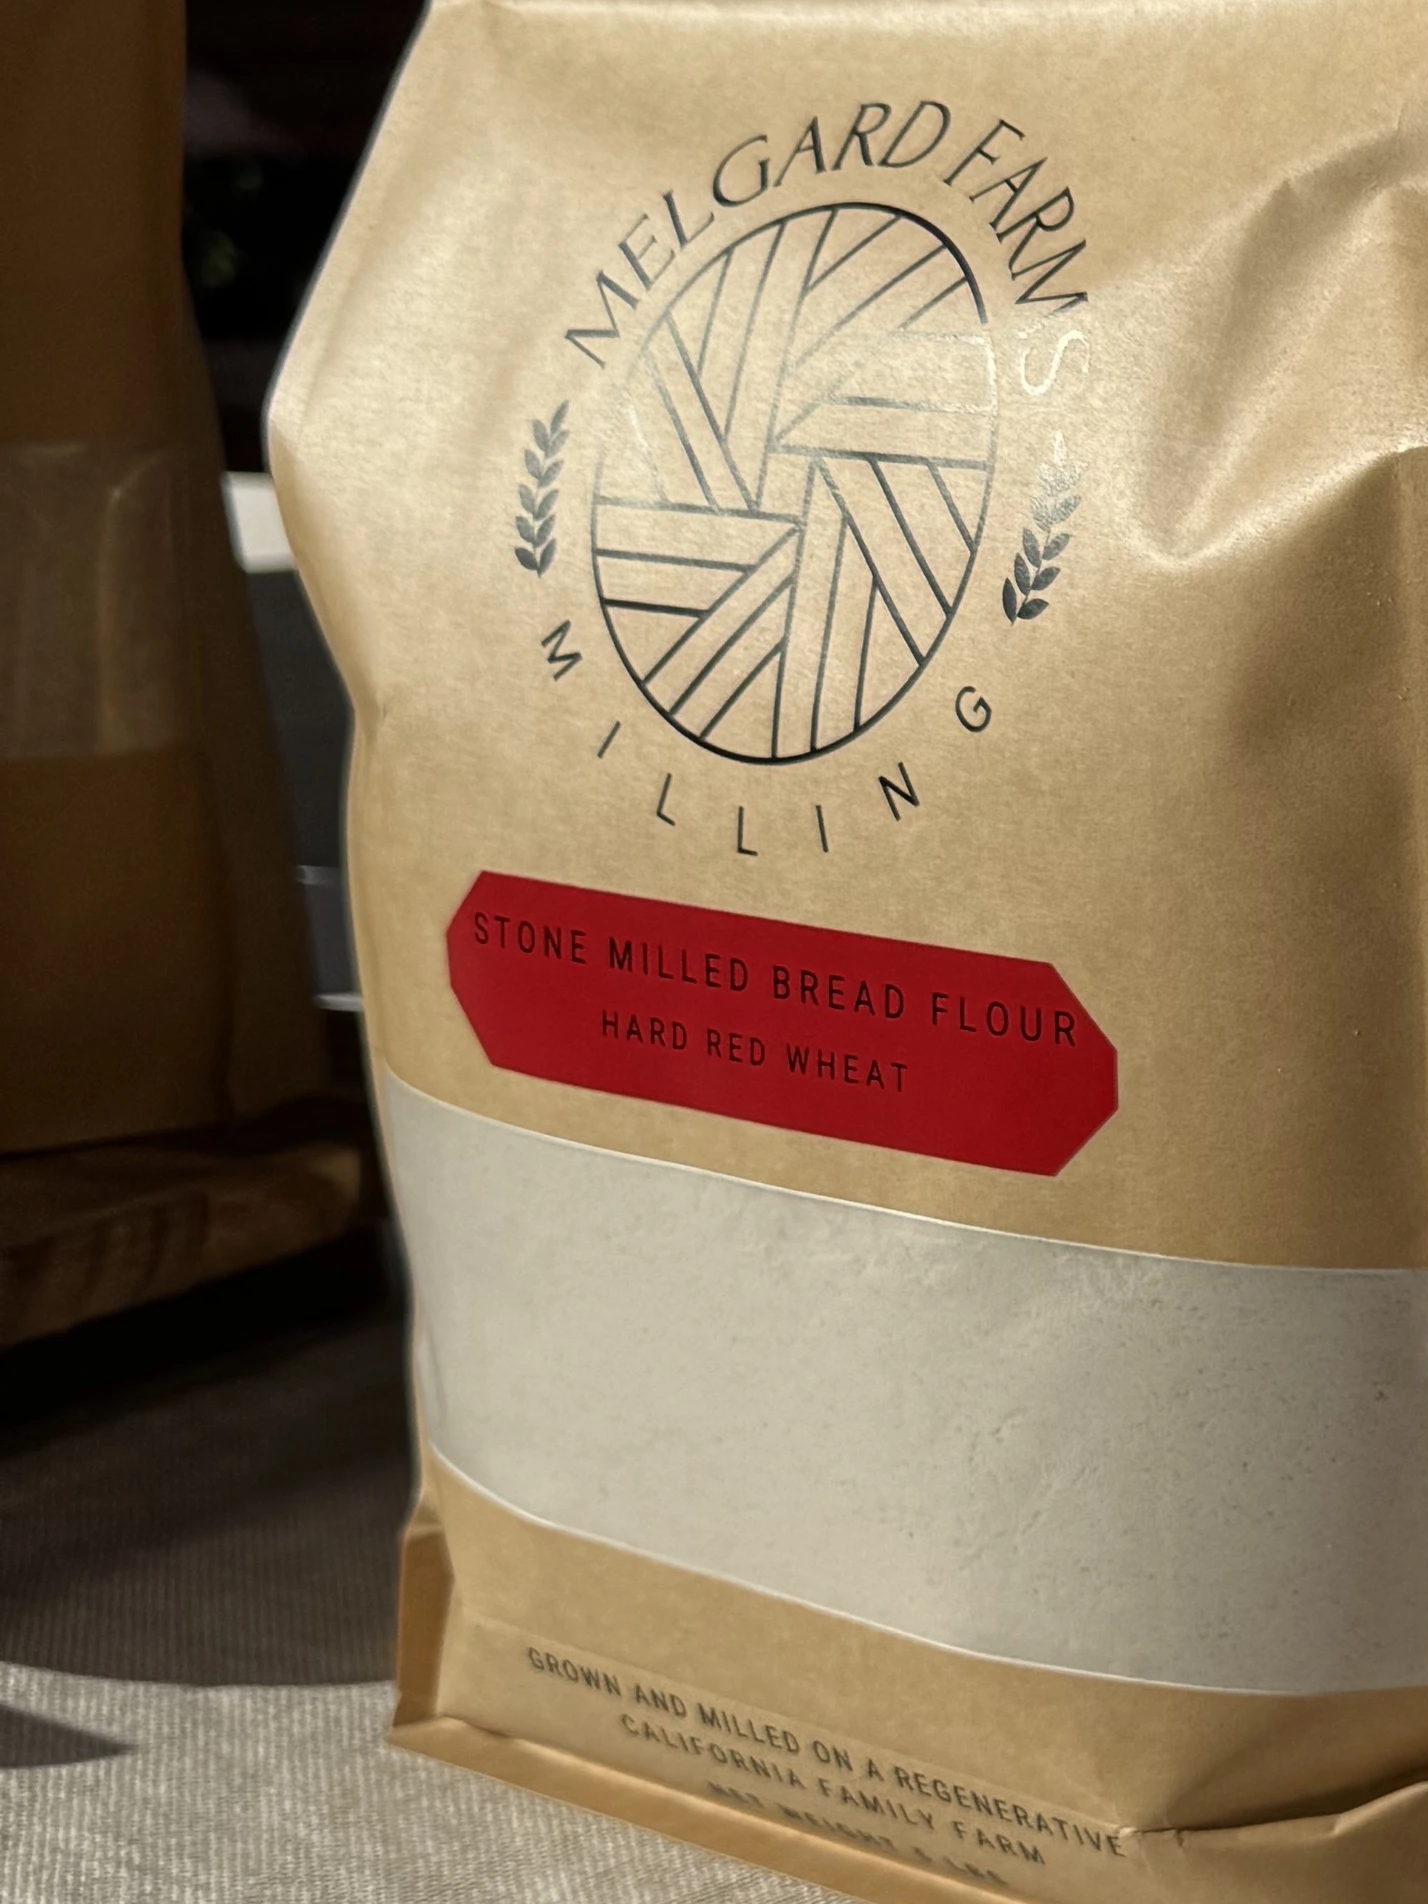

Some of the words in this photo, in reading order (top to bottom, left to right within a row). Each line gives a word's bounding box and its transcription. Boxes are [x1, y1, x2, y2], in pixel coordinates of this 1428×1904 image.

[565, 101, 951, 369] MELGARD
[943, 119, 1090, 396] FARMS
[541, 620, 992, 856] MILLING
[474, 912, 587, 965] STONE
[609, 936, 748, 992] MILLED
[772, 964, 905, 1020] BREAD
[931, 991, 1077, 1047] FLOUR
[602, 1008, 688, 1051] HARD
[707, 1029, 766, 1067] RED
[786, 1043, 909, 1093] WHEAT
[529, 1647, 621, 1696] GROWN
[634, 1683, 688, 1718] AND
[697, 1702, 801, 1753] MILLED
[812, 1740, 854, 1773] ON
[866, 1758, 885, 1783] A
[893, 1764, 1127, 1859] REGENERATIVE
[620, 1713, 806, 1791] CALIFORNIA
[818, 1776, 935, 1831] FAMILY
[952, 1820, 1046, 1866] FARM
